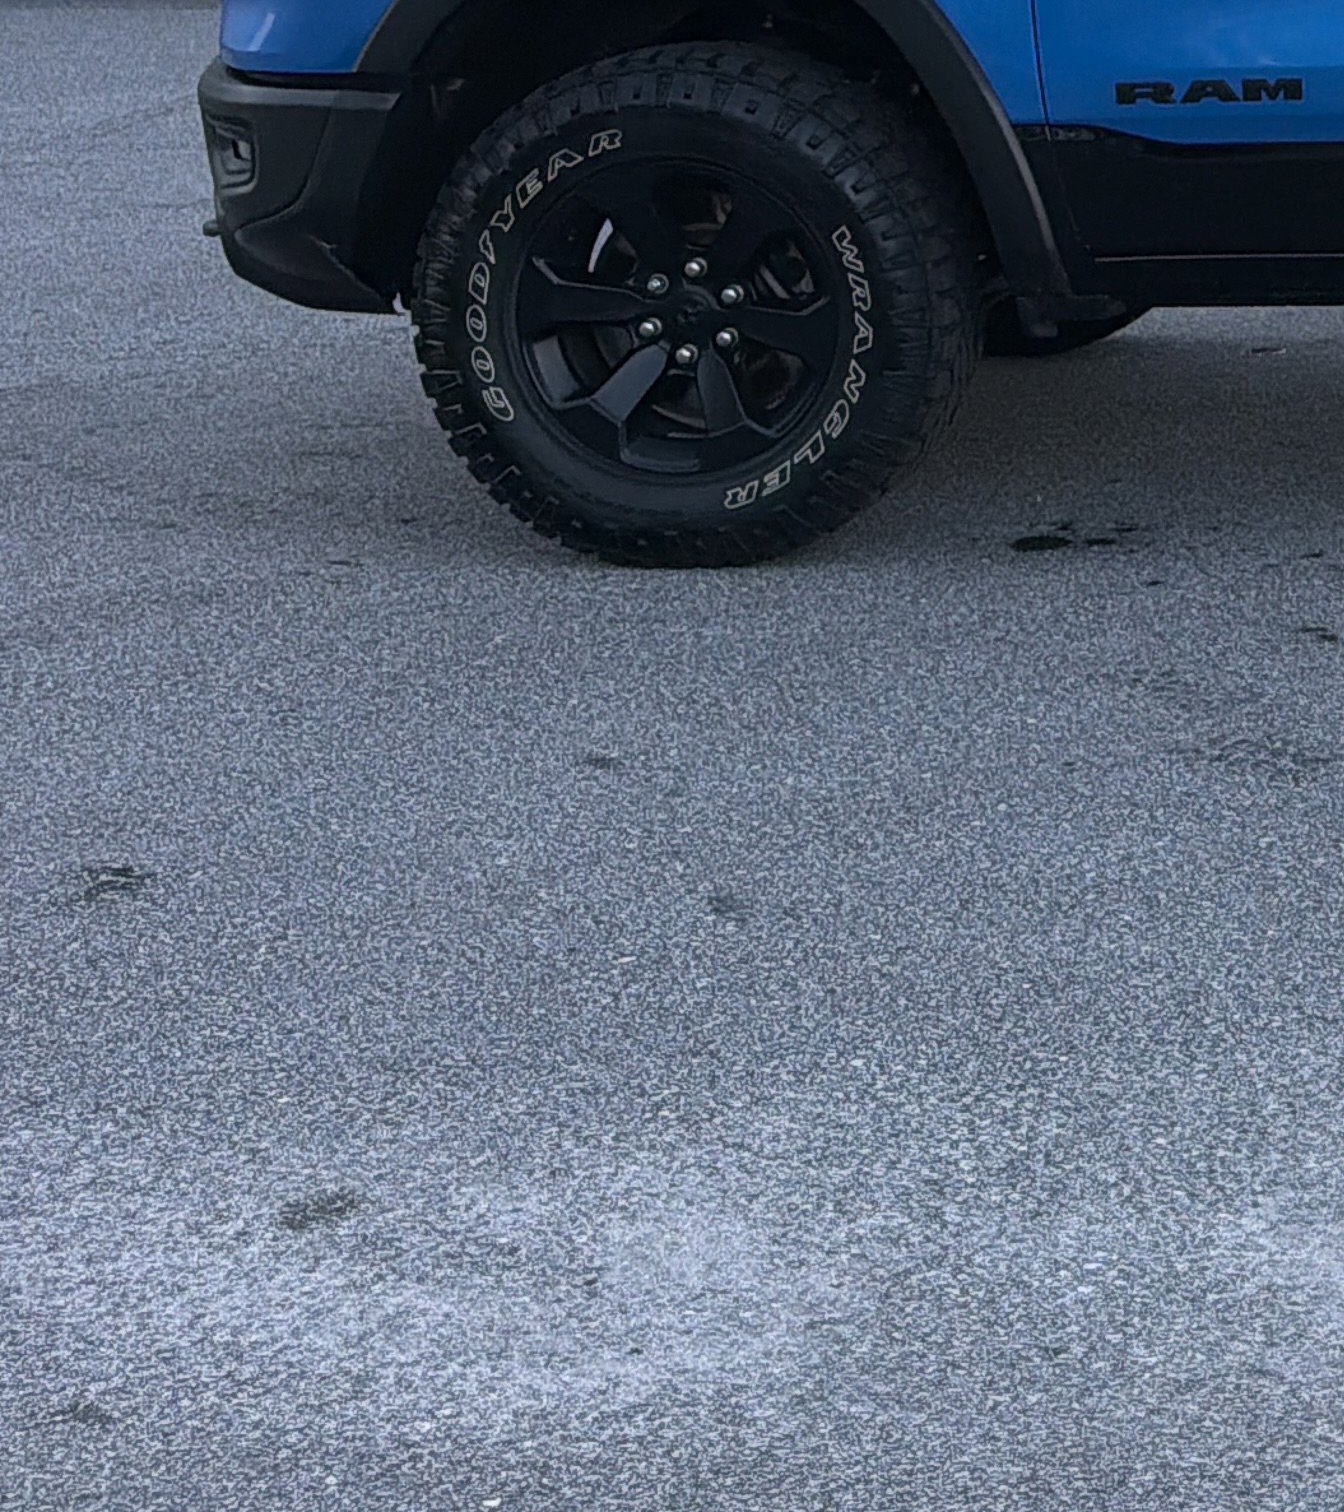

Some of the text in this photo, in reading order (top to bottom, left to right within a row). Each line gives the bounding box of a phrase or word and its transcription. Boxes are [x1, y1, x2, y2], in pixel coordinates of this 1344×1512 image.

[1115, 78, 1303, 104] RAM
[466, 129, 622, 421] GOODYEAR
[724, 226, 872, 509] WRANGLER
